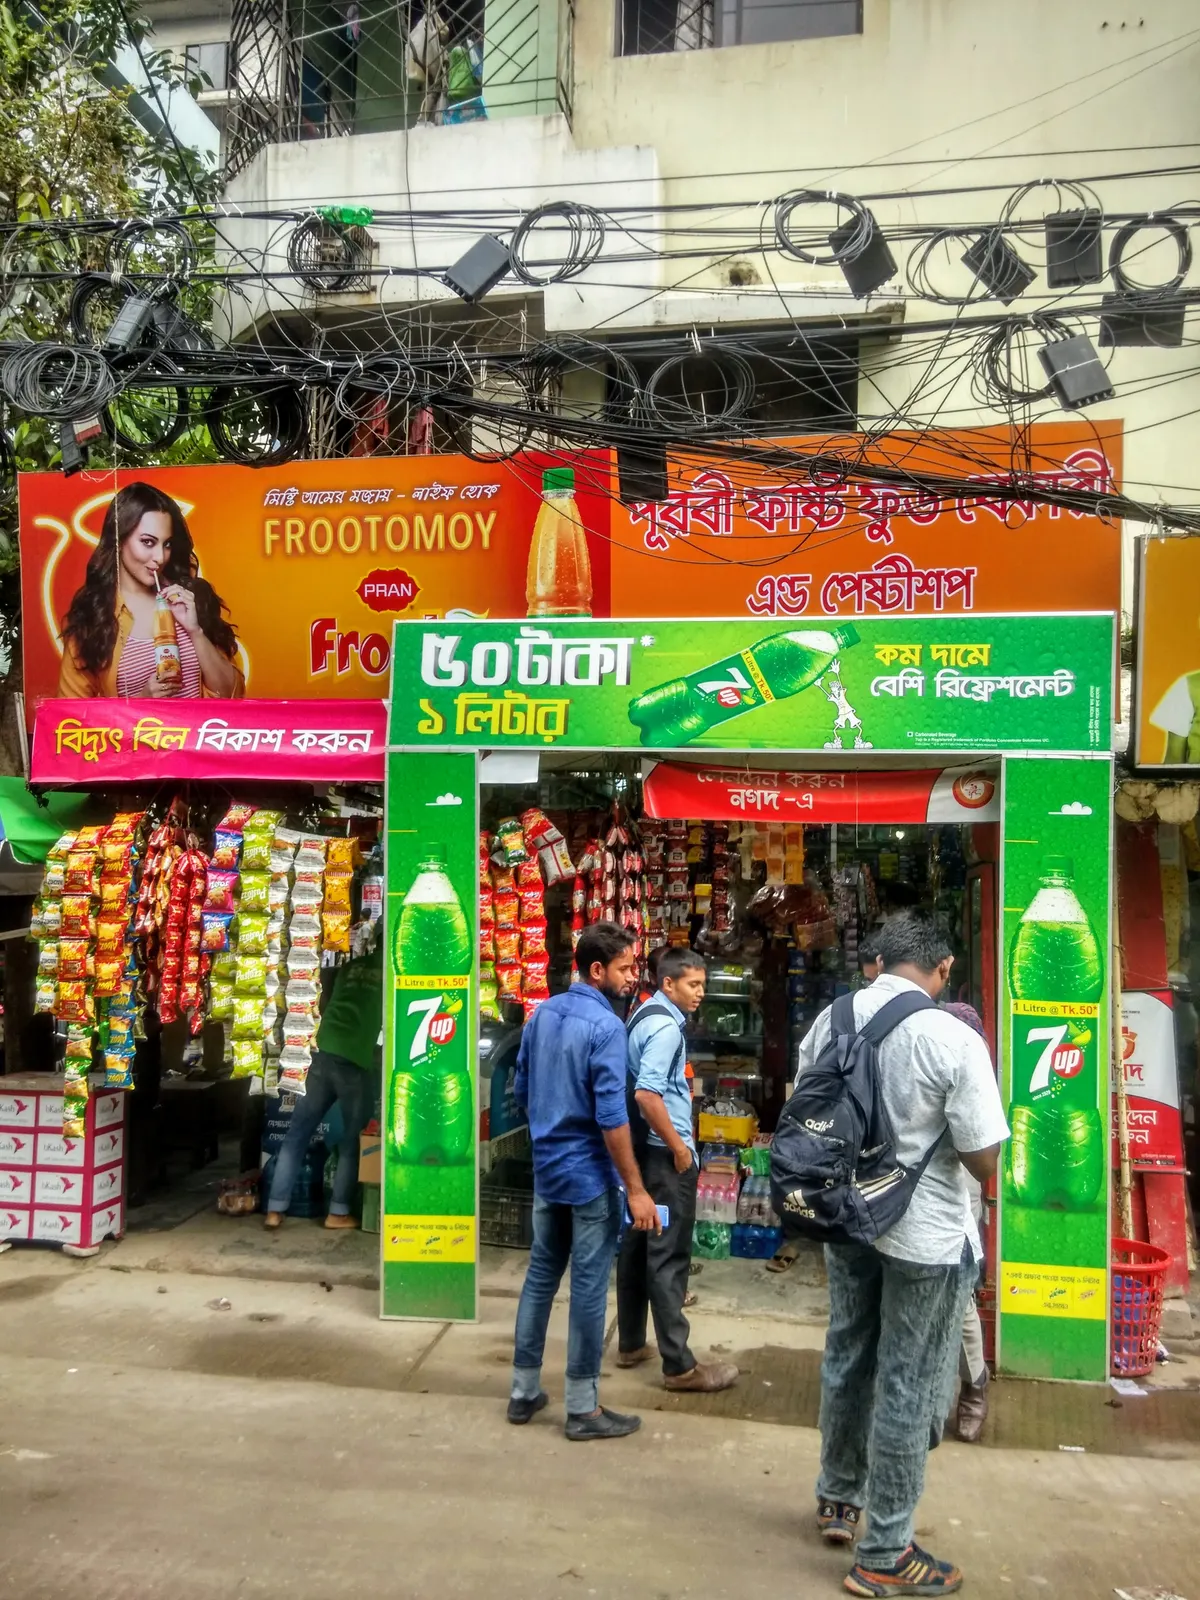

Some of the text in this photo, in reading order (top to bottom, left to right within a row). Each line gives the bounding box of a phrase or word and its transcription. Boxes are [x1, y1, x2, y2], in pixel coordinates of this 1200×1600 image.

[264, 487, 299, 507] মিষ্টি
[302, 490, 347, 504] আমের
[412, 482, 458, 501] লাইফ
[460, 484, 501, 499] হোক
[264, 510, 497, 556] FROOTOMOY
[364, 583, 412, 598] PRAN
[310, 617, 391, 677] Fro
[874, 643, 991, 668] কম দামে
[870, 668, 1074, 702] বেশি রিফ্রেশমেন্ট
[418, 689, 572, 743] ১ লিটার
[55, 717, 374, 761] বিদ্যুৎ বিল বিকাশ করুন
[697, 769, 846, 788] লেনদেন করুন
[727, 788, 781, 810] নগদ
[404, 978, 425, 987] Litre
[1013, 1002, 1019, 1011] 1
[1023, 1003, 1047, 1013] Litre
[1049, 1006, 1059, 1015] @
[0, 1104, 15, 1113] Kash
